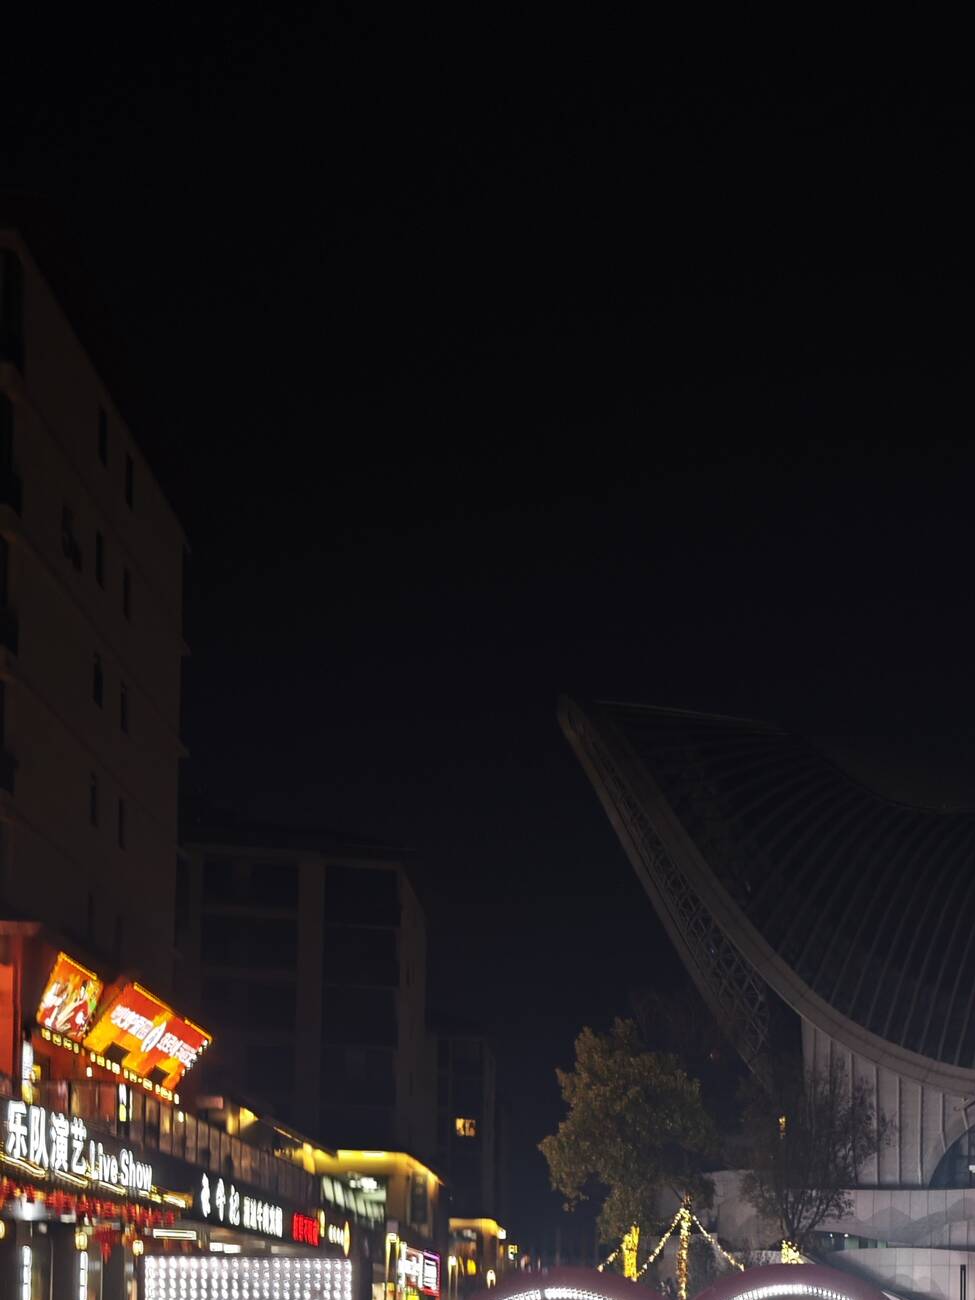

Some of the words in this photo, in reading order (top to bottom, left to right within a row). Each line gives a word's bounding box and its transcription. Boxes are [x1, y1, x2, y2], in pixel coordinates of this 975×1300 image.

[6, 1100, 87, 1175] 乐队演艺
[89, 1140, 118, 1184] Live
[119, 1149, 153, 1193] Show
